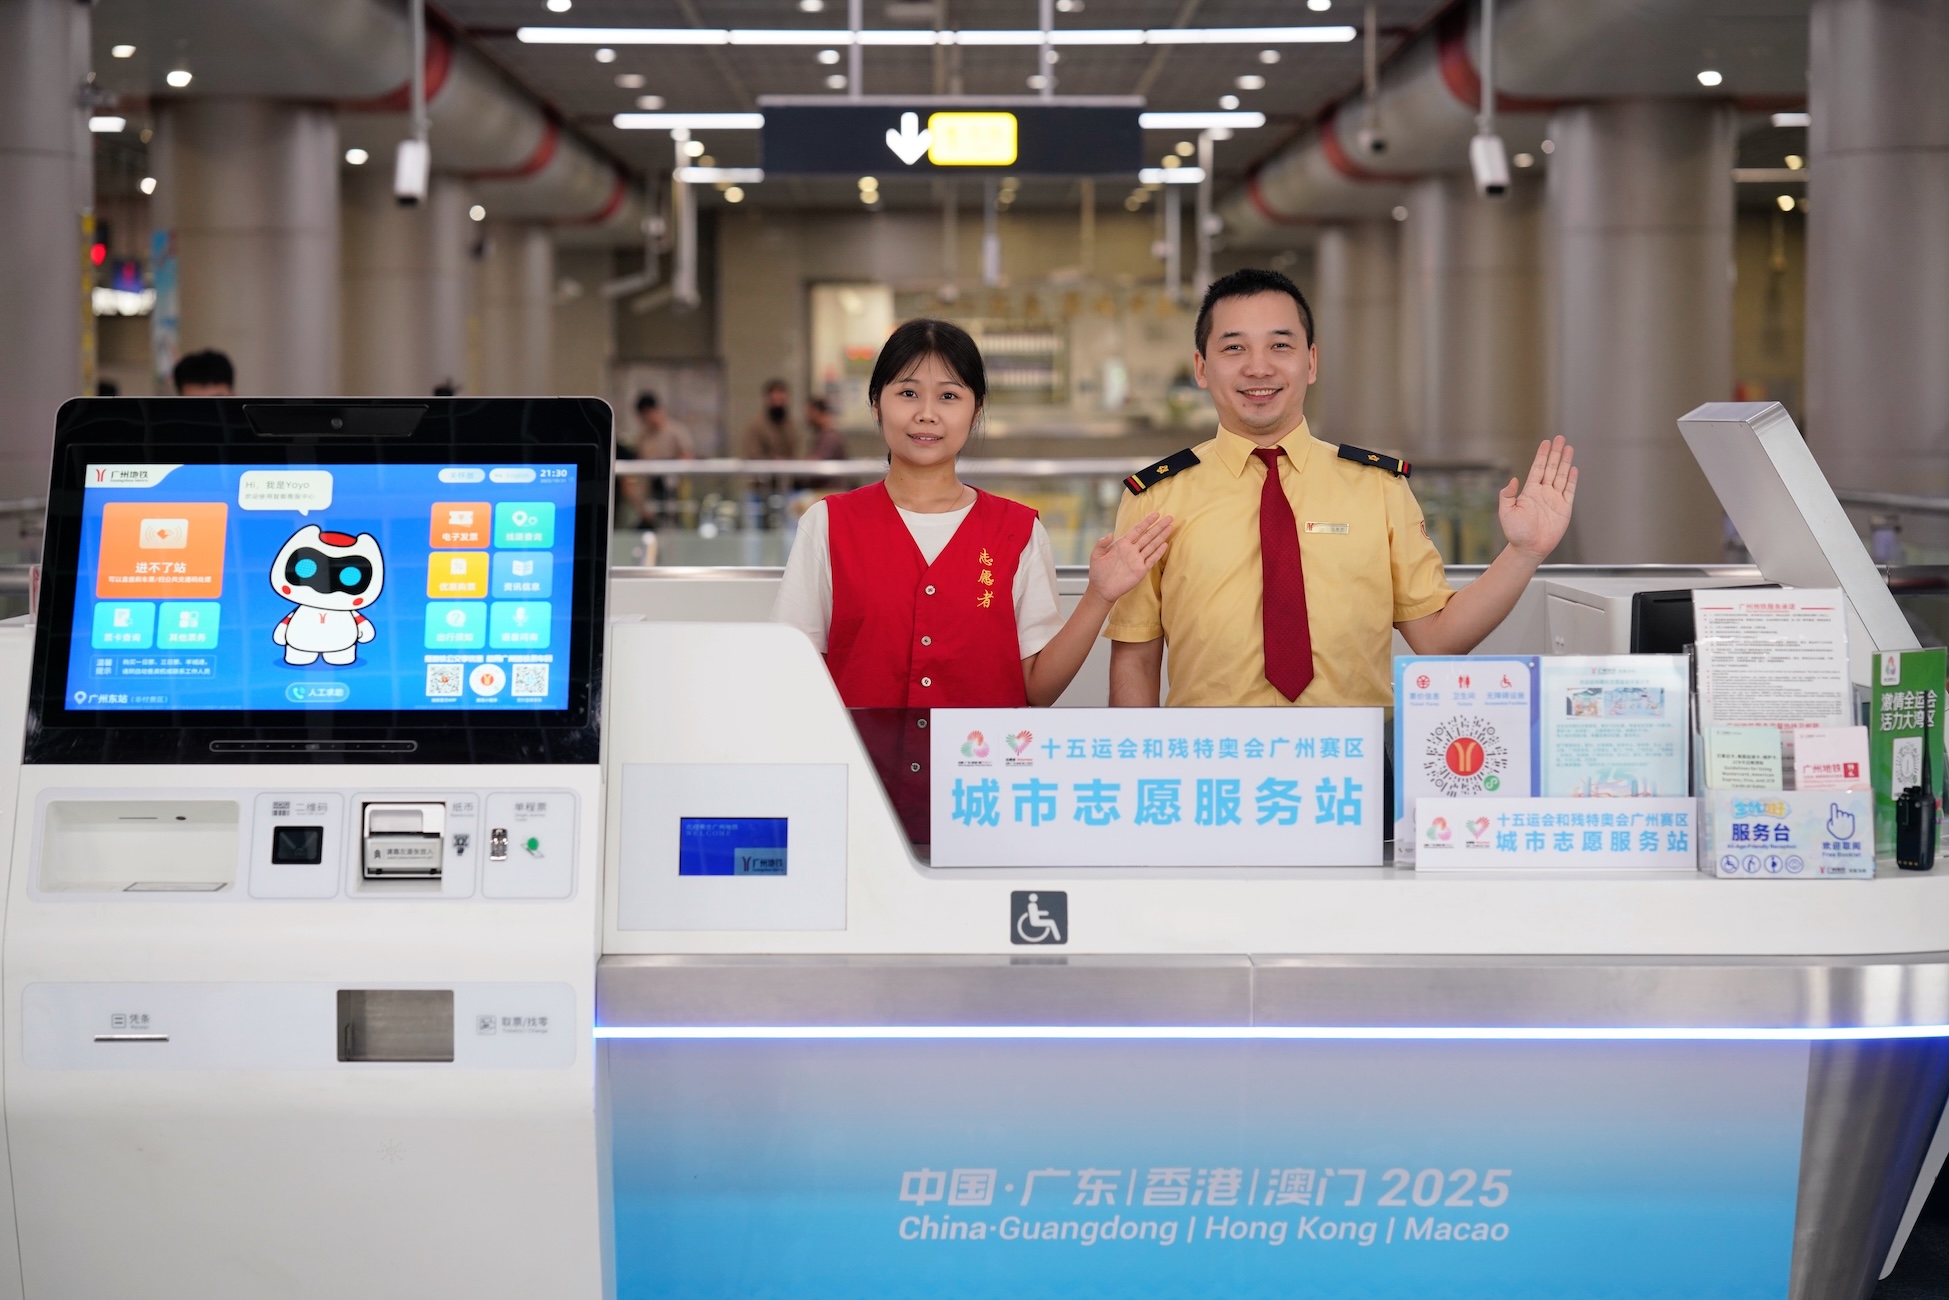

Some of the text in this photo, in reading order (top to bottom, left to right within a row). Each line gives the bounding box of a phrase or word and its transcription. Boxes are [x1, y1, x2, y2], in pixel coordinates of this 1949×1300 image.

[110, 470, 149, 480] 广州地铁
[539, 469, 568, 478] 21:30
[441, 532, 479, 542] 电子发票
[135, 561, 187, 575] 进不了站
[976, 547, 996, 609] 志愿者
[308, 687, 345, 697] 人工求助
[1453, 691, 1476, 701] 卫生间
[1486, 691, 1525, 701] 无障碍设施
[88, 693, 129, 704] 广州东站
[1880, 689, 1938, 713] 激情全运会
[1039, 737, 1366, 760] 十五运会和残特奥会广州赛区
[1803, 763, 1841, 774] 广州地铁
[295, 802, 328, 813] 二维码
[452, 802, 475, 812] 纸币
[515, 802, 547, 812] 单程票
[951, 777, 1364, 828] 城市志愿服务站
[1497, 812, 1689, 828] 十五运会和残特奥会广州赛区
[1732, 823, 1791, 842] 服务台
[1495, 830, 1689, 853] 城市志愿服务站
[1822, 842, 1862, 851] 欢迎取阅
[129, 1013, 150, 1024] 凭条
[501, 1016, 549, 1027] 取票/找零
[1377, 1167, 1514, 1208] 2025
[1204, 1215, 1288, 1246] Hong
[1297, 1215, 1378, 1246] Kong
[1402, 1215, 1512, 1242] Macao
